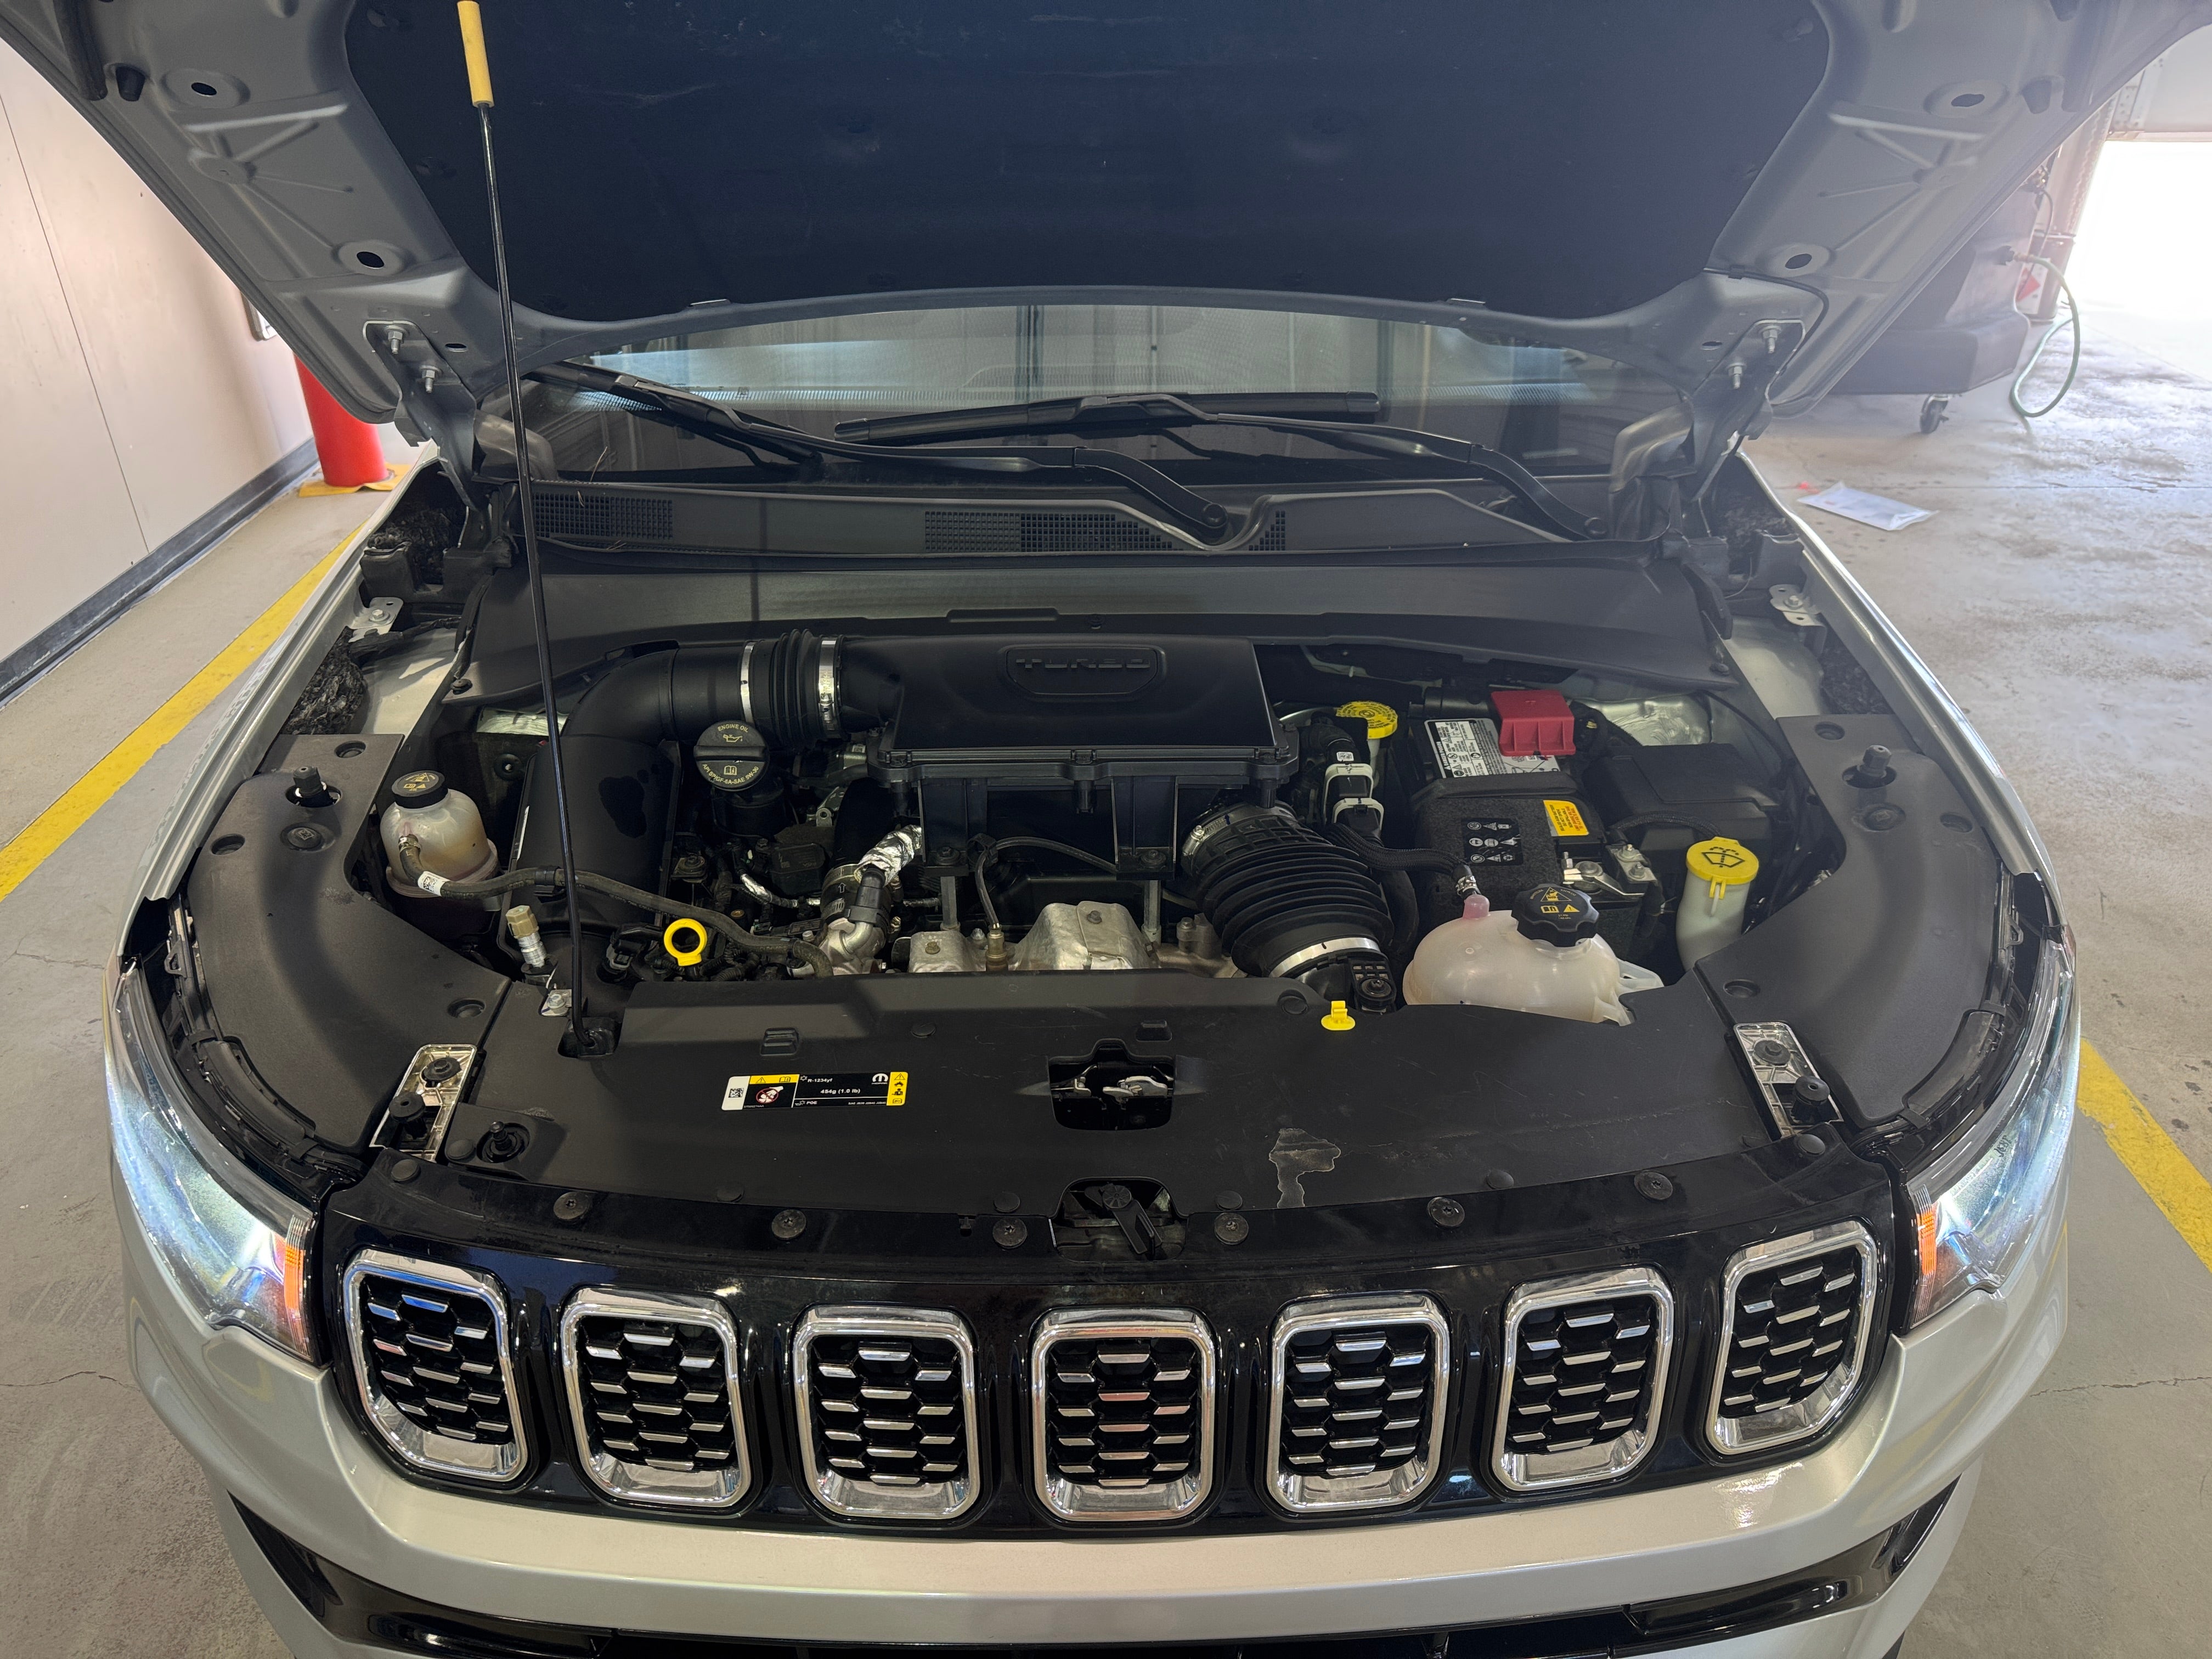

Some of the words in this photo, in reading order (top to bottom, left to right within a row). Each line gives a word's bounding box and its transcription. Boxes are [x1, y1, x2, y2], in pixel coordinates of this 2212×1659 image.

[718, 724, 739, 732] ENGINE
[702, 764, 710, 774] API
[746, 766, 759, 780] 5W-30
